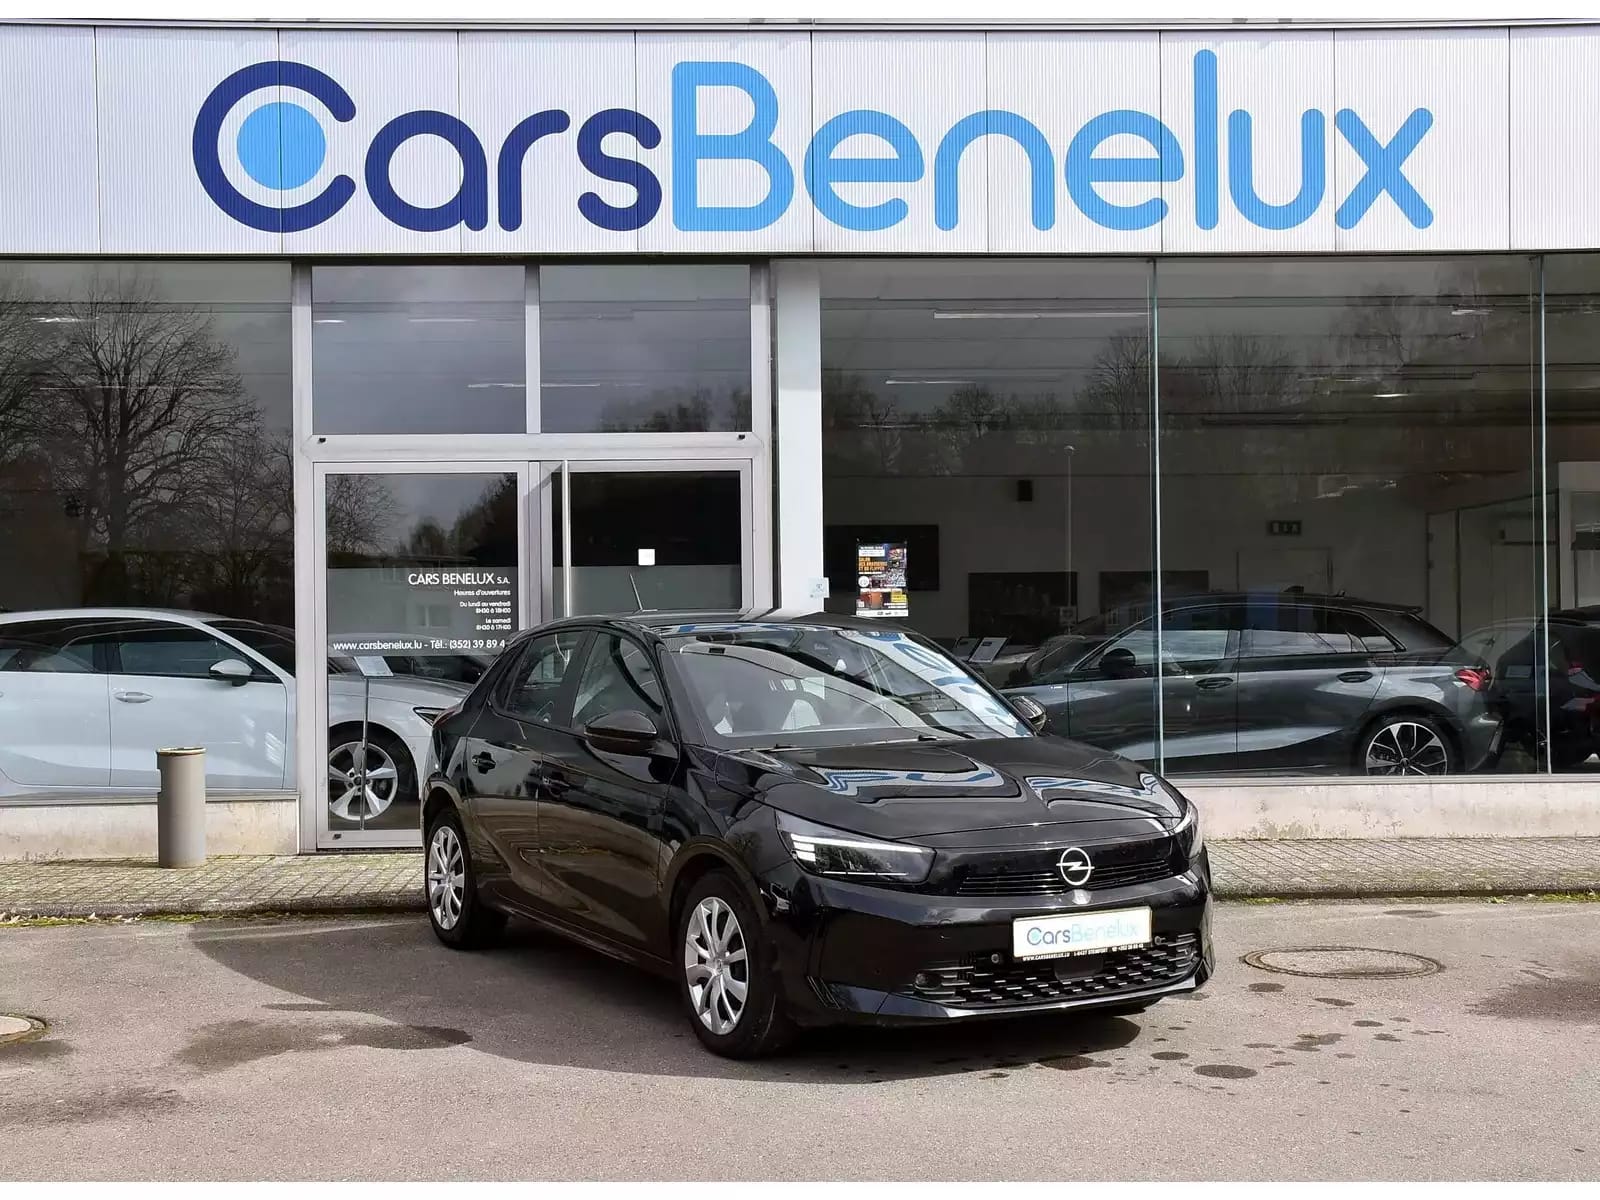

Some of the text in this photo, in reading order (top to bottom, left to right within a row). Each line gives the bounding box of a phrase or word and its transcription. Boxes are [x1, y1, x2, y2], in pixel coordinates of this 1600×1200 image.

[192, 49, 1434, 233] CarsBenelux
[408, 573, 440, 585] CARS
[442, 573, 495, 585] BENELUX
[454, 588, 511, 597] Heures d'ouvertures
[333, 640, 422, 650] www.carsbenelux.lu
[430, 640, 448, 649] Tél.:
[450, 640, 471, 650] (352)
[472, 640, 484, 649] 39
[486, 640, 497, 649] 89
[499, 640, 506, 649] 4
[1027, 918, 1139, 946] CarsBenelux
